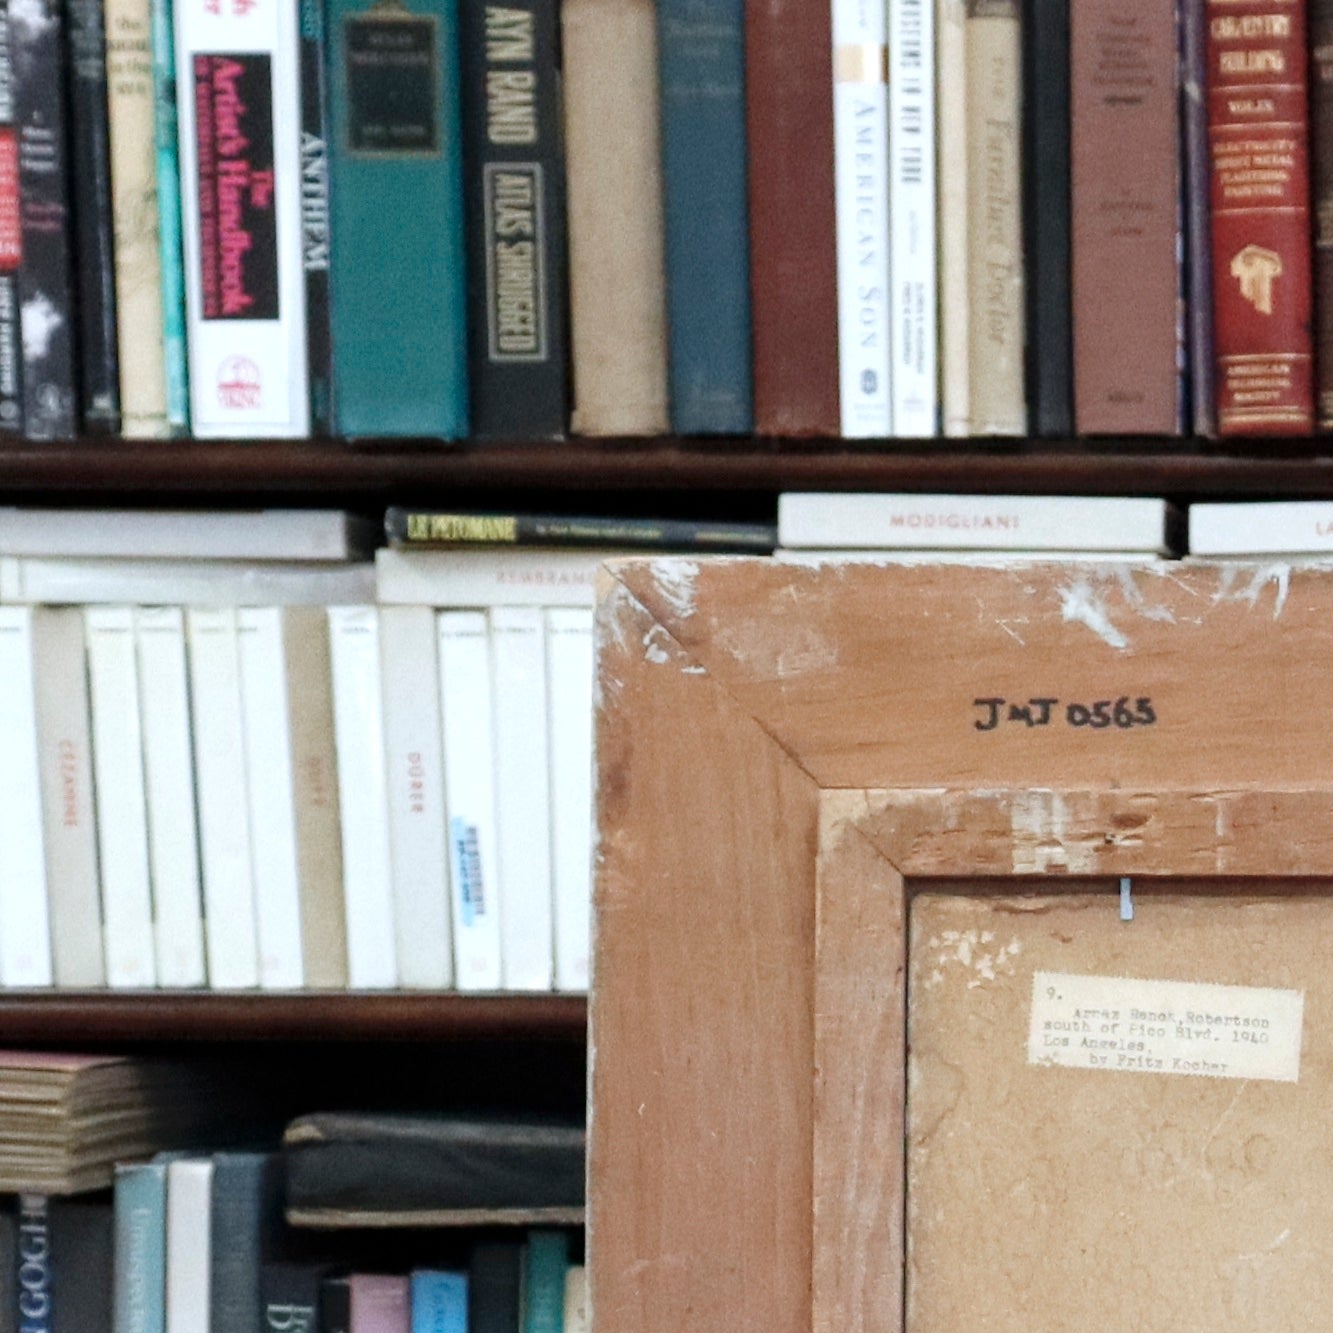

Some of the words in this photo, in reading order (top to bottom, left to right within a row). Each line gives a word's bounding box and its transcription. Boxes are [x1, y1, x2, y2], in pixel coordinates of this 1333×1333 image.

[485, 6, 535, 60] AYN
[487, 70, 538, 144] RAND
[301, 132, 328, 271] ANTHEM
[496, 173, 533, 234] ATLAS
[854, 99, 879, 266] AMERICAN
[496, 241, 535, 351] SHRUGGED
[858, 286, 882, 349] SON
[889, 512, 1022, 531] MODIGLIANI
[1043, 1020, 1091, 1033] south
[1099, 1022, 1121, 1034] of
[1043, 1034, 1070, 1048] Los
